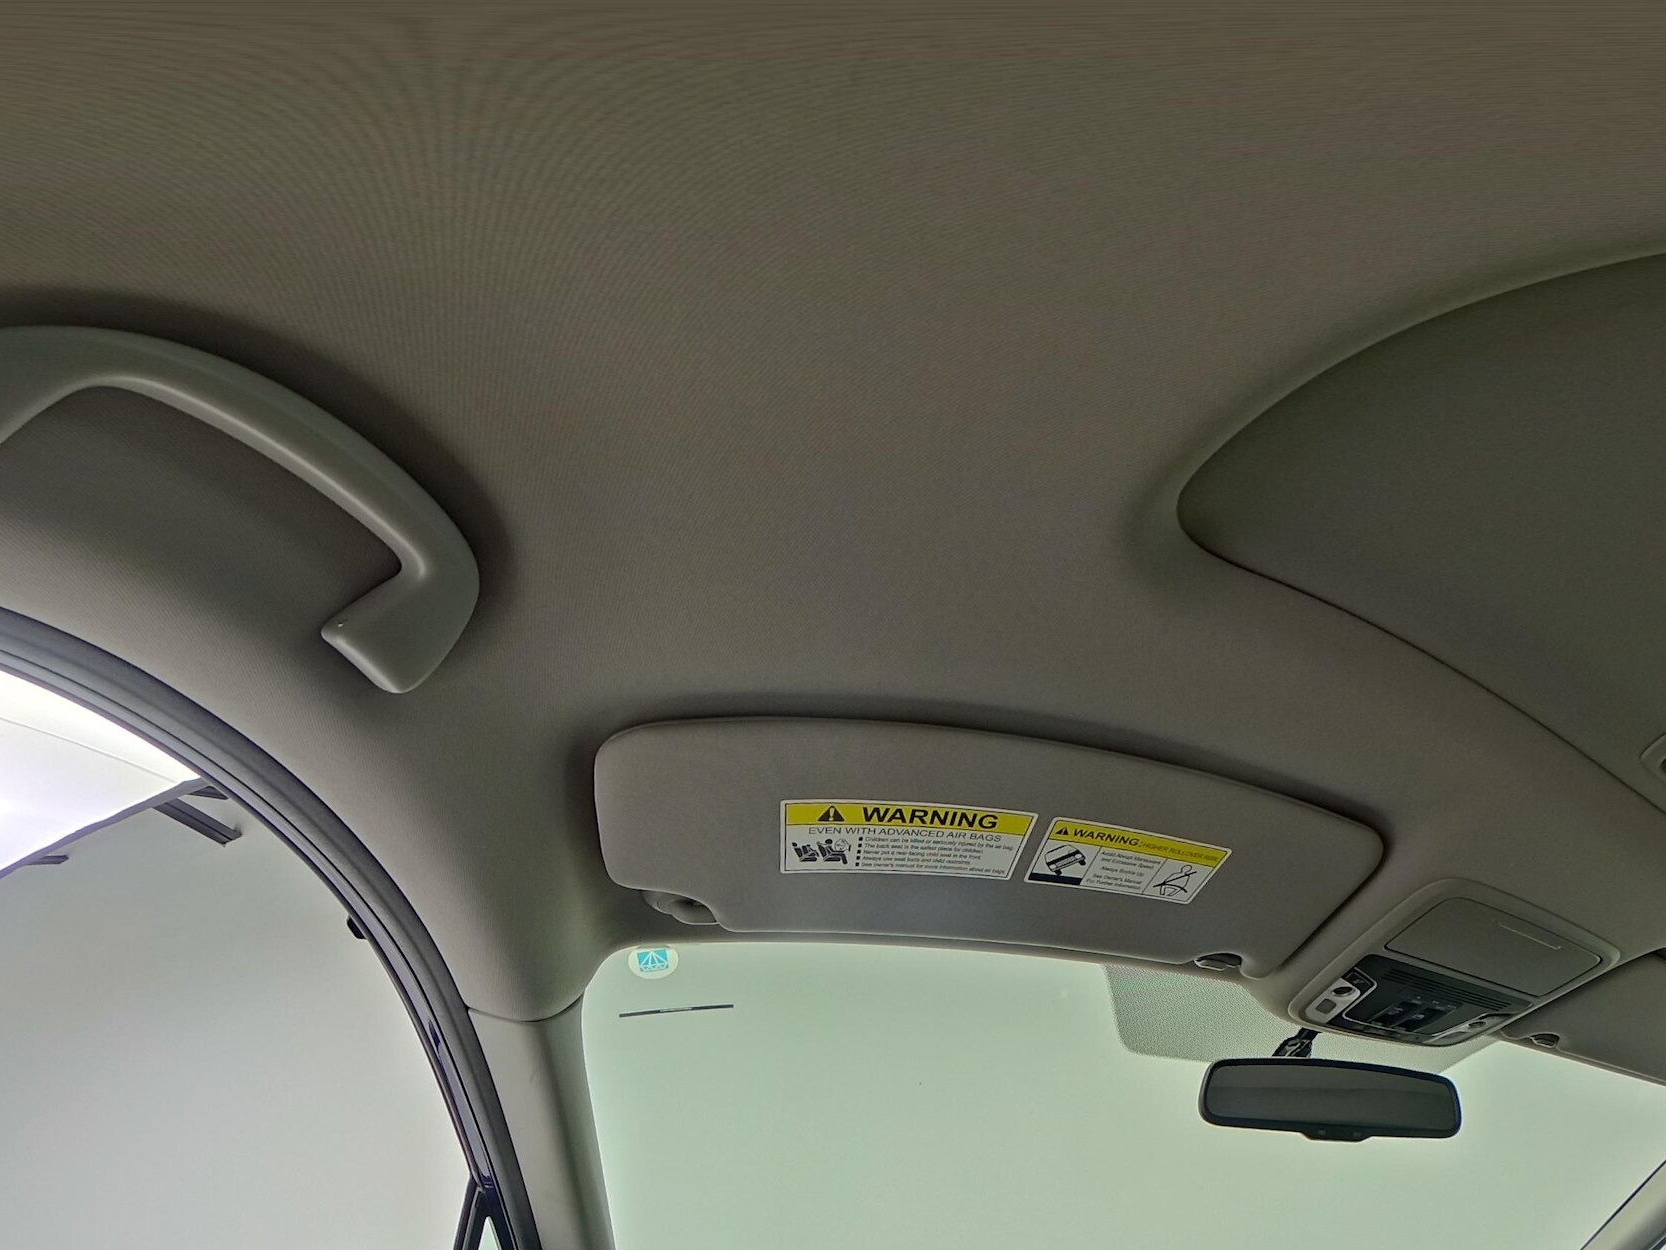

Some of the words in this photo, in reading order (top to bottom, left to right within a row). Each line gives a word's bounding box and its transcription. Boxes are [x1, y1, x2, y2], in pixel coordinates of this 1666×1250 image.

[862, 807, 998, 829] WARNING
[808, 827, 842, 835] EVEN
[845, 827, 876, 835] WITH
[878, 828, 945, 838] ADVANCED
[946, 831, 967, 840] AIR
[969, 833, 1002, 842] BAGS
[1169, 846, 1203, 859] ROLLOVER
